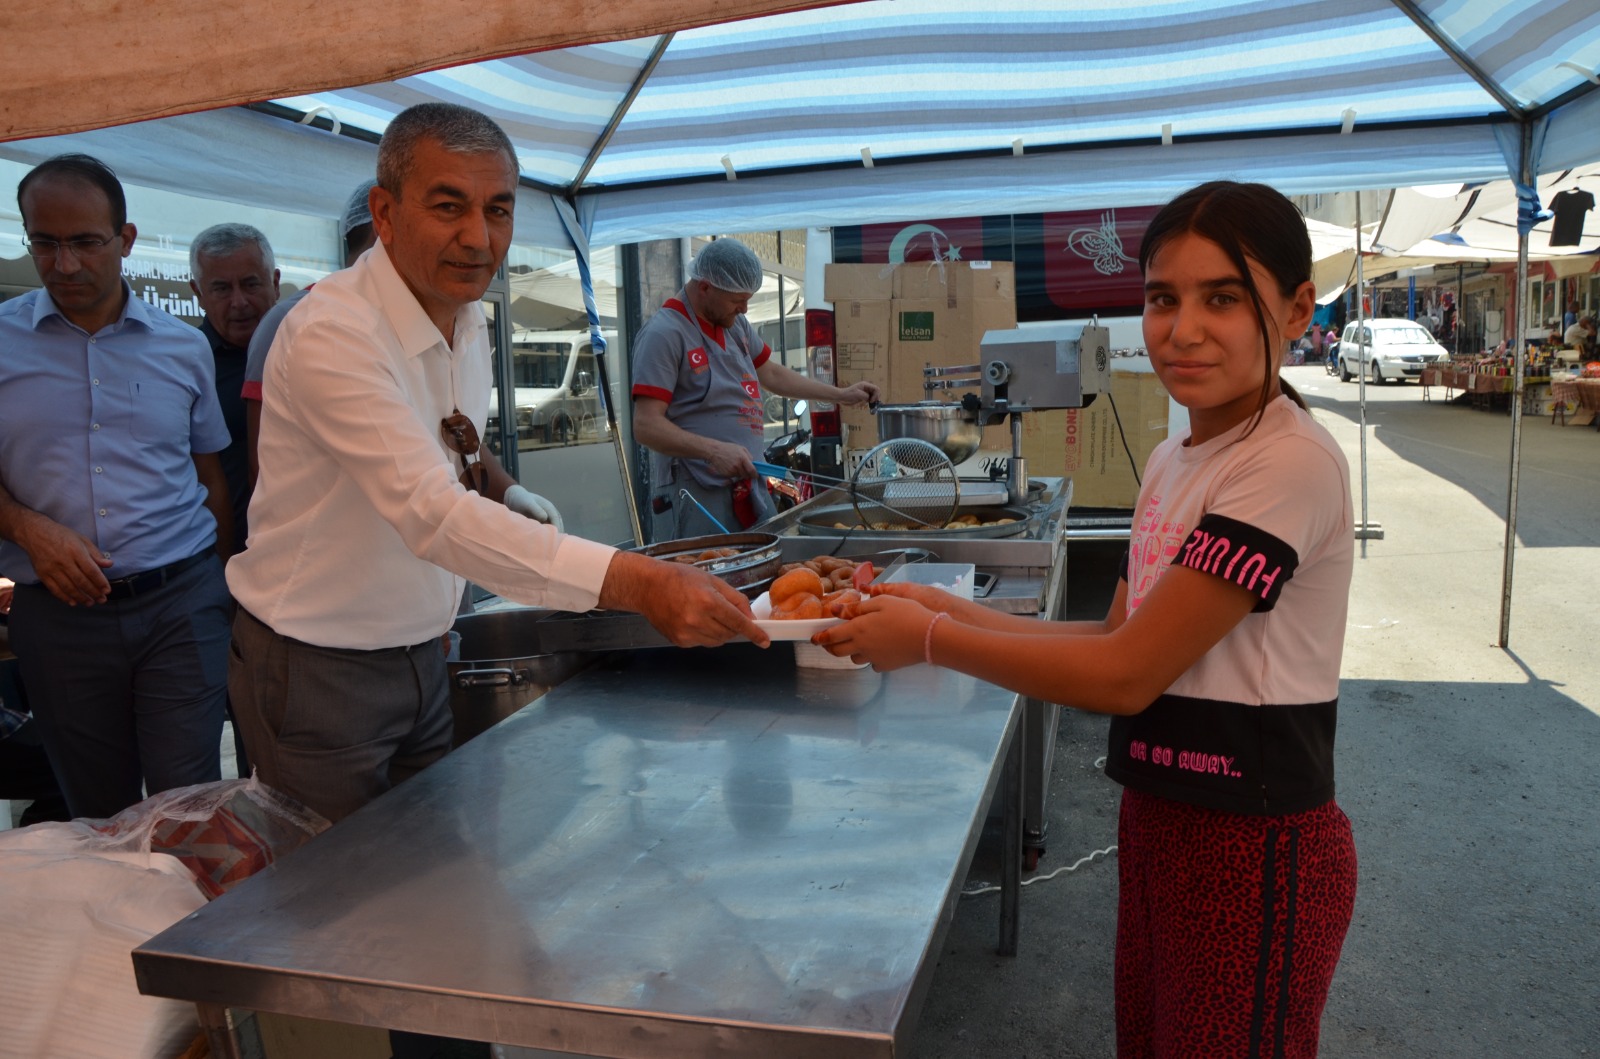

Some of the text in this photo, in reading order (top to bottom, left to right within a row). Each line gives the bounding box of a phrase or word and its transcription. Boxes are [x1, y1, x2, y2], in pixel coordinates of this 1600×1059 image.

[121, 258, 160, 280] OÇARLI
[1130, 740, 1147, 761] OR
[1152, 745, 1173, 767] GO
